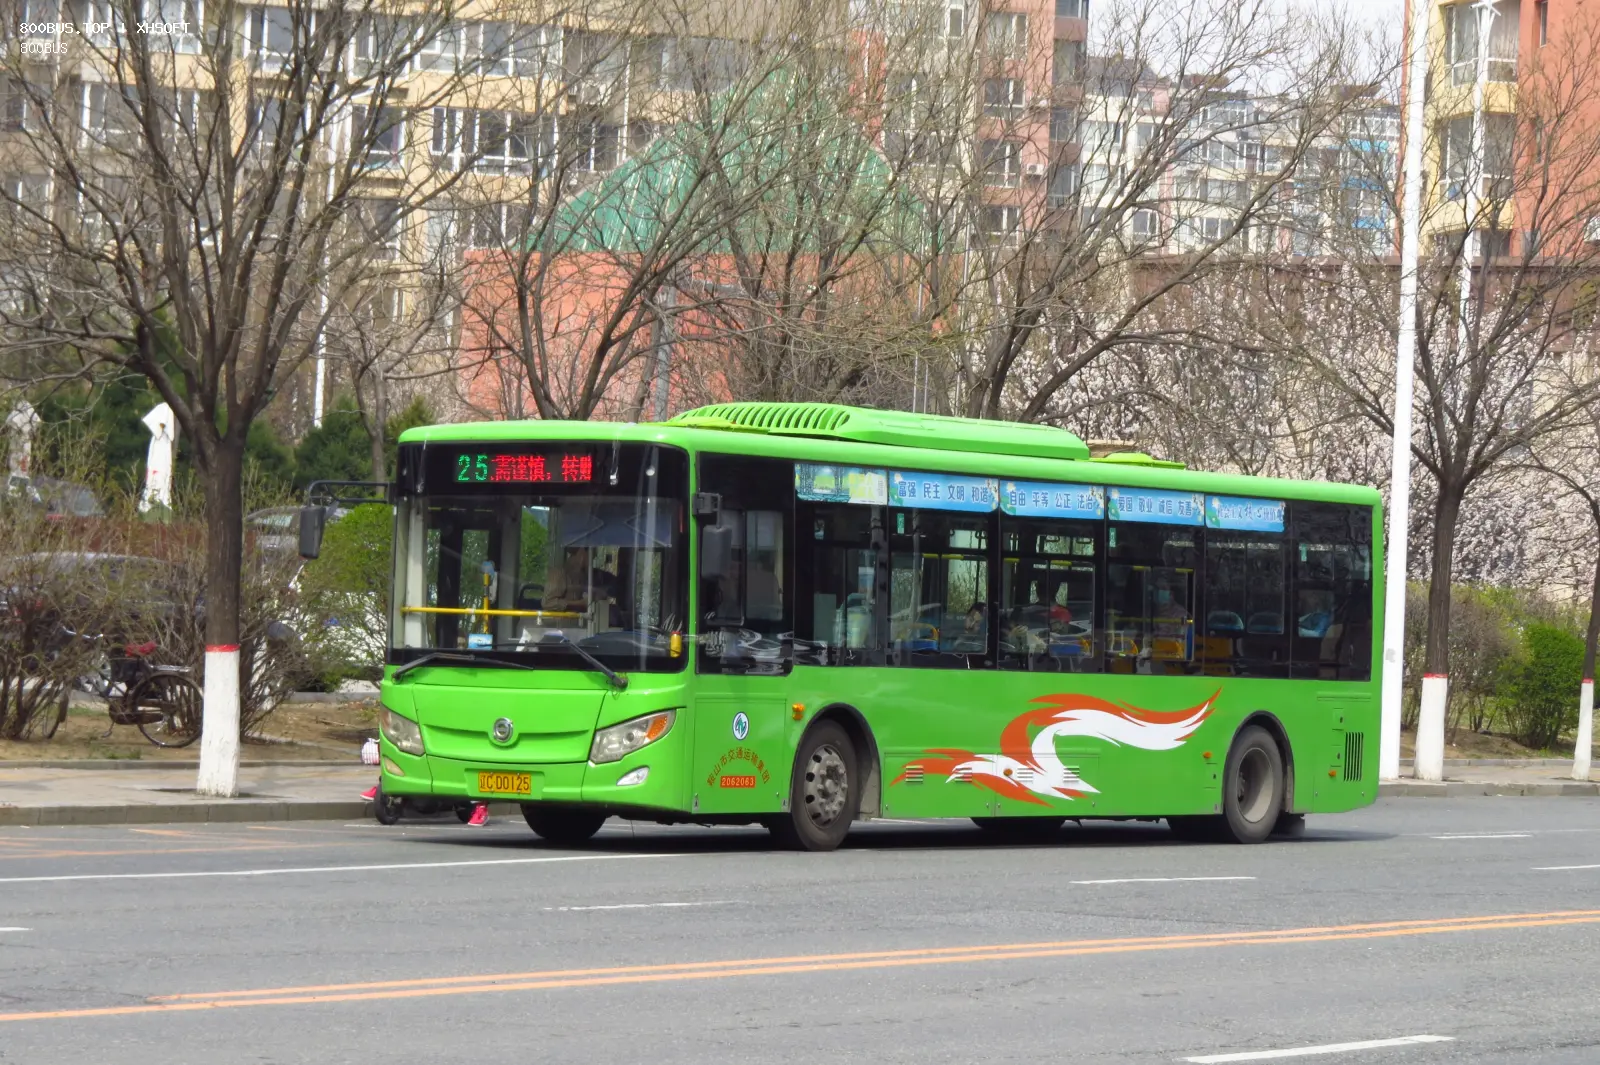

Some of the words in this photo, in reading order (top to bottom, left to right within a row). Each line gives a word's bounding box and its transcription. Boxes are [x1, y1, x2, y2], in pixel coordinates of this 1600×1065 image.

[457, 455, 488, 481] 25
[898, 481, 917, 498] 富强
[923, 483, 941, 500] 民主
[947, 484, 965, 501] 文明
[971, 486, 988, 503] 和谐
[1009, 491, 1026, 506] 自由
[1031, 491, 1049, 508] 平等
[1055, 493, 1071, 508] 公正
[1076, 494, 1094, 510] 法治
[1117, 496, 1133, 513] 爱国
[1139, 497, 1153, 513] 敬业
[1158, 498, 1173, 515] 诚信
[1177, 499, 1193, 516] 友善
[721, 777, 755, 786] 2062063
